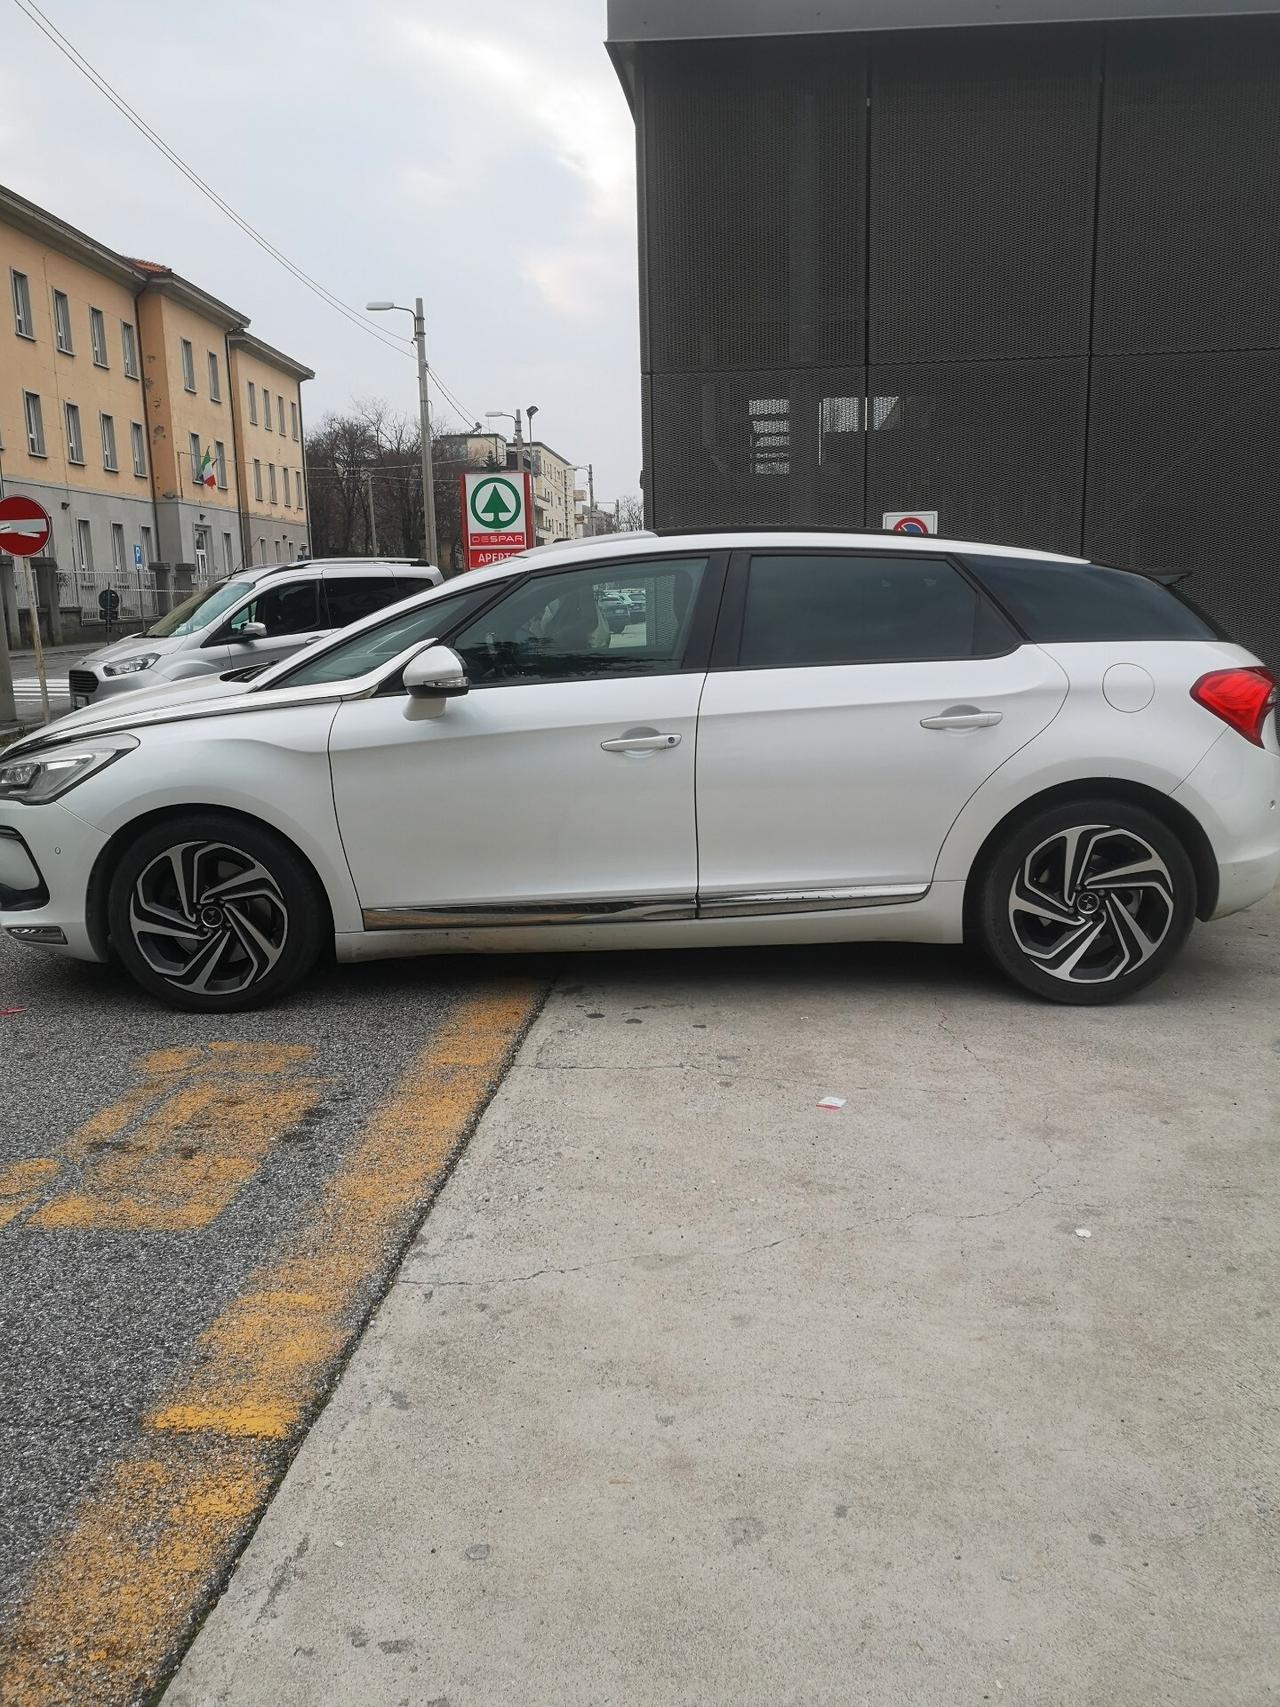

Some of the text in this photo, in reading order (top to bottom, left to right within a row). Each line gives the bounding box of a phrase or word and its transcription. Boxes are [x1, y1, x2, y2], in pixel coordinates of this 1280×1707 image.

[472, 535, 523, 543] DESPAR
[136, 546, 141, 561] P
[478, 552, 515, 563] APERT
